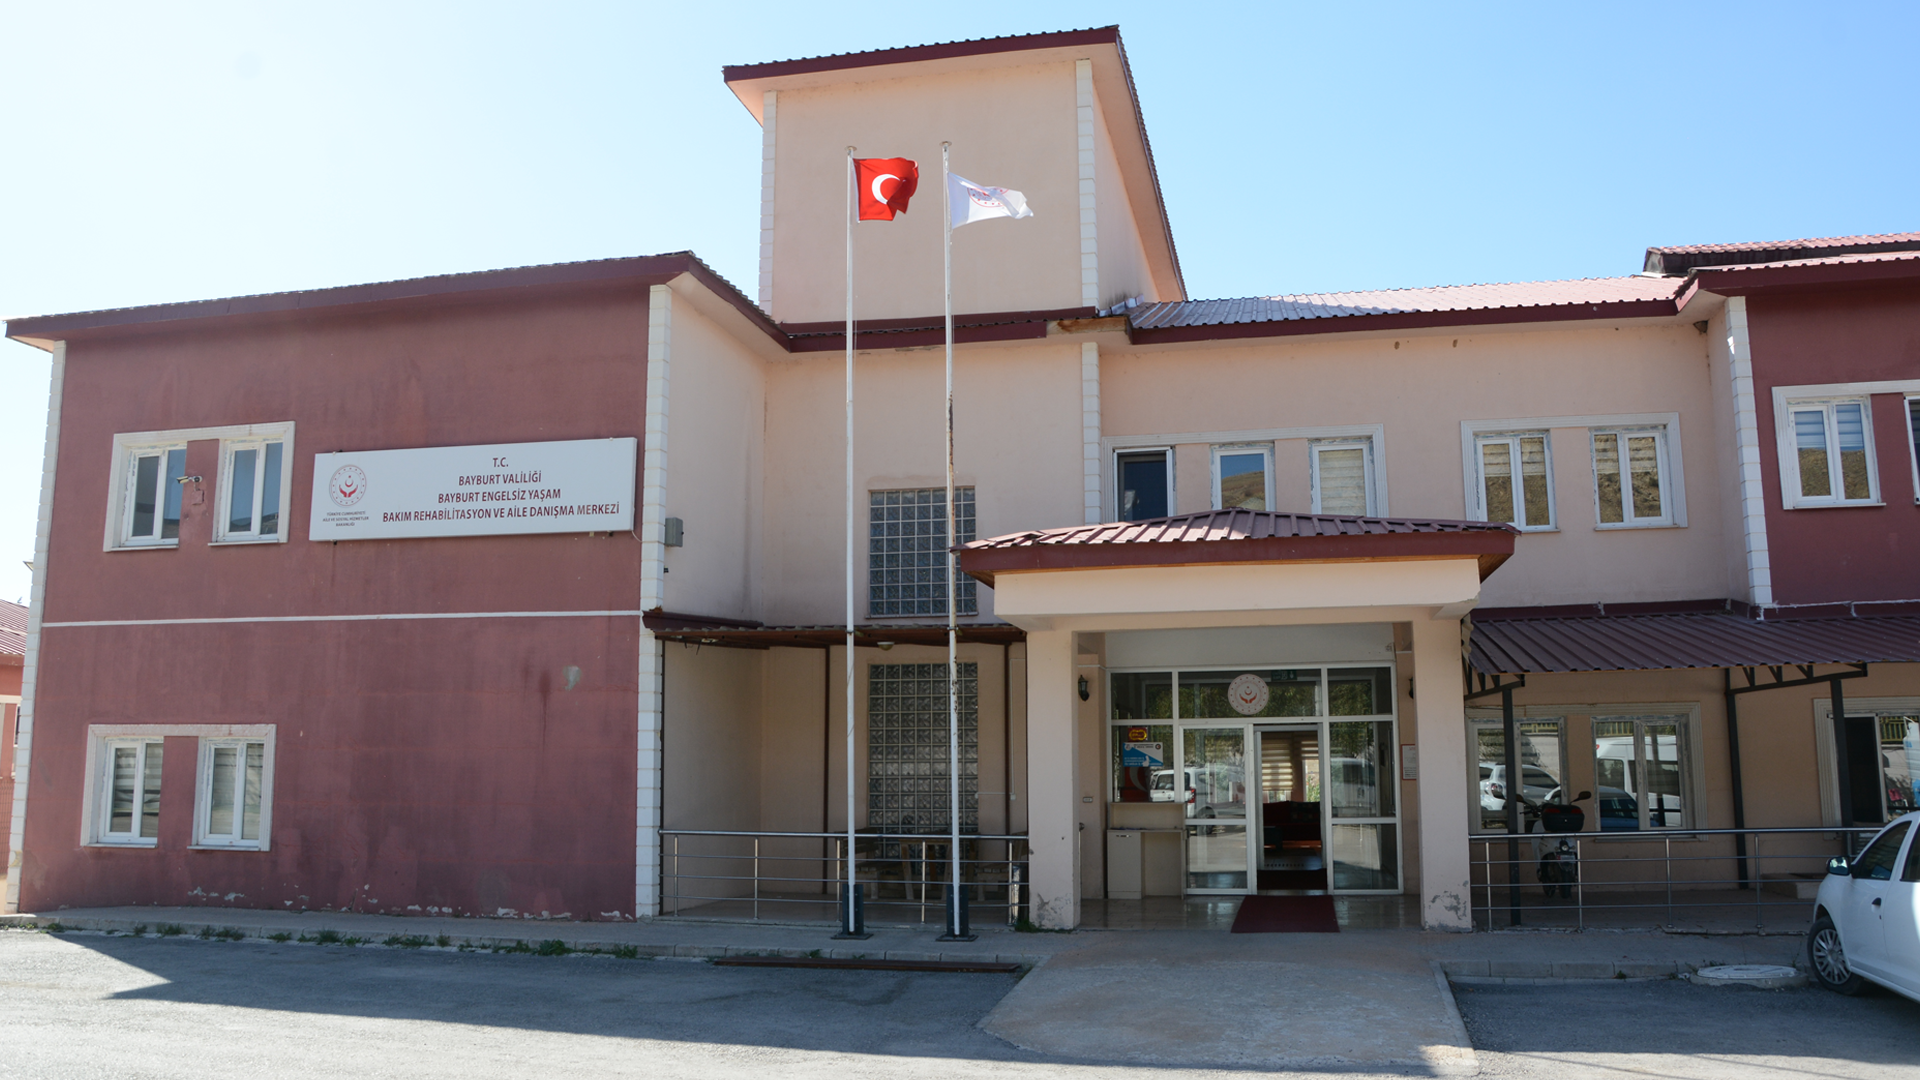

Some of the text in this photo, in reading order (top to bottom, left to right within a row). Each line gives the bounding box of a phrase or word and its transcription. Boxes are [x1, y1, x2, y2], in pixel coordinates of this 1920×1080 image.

[493, 457, 509, 468] T.C.
[458, 470, 542, 486] BAYBURT VALİLİĞİ
[438, 488, 561, 503] BAYBURT ENGELSİZ YAŞAM
[383, 501, 620, 522] BAKIM REHABİLİTASYON VE AİLE DANIŞMA MERKEZİ
